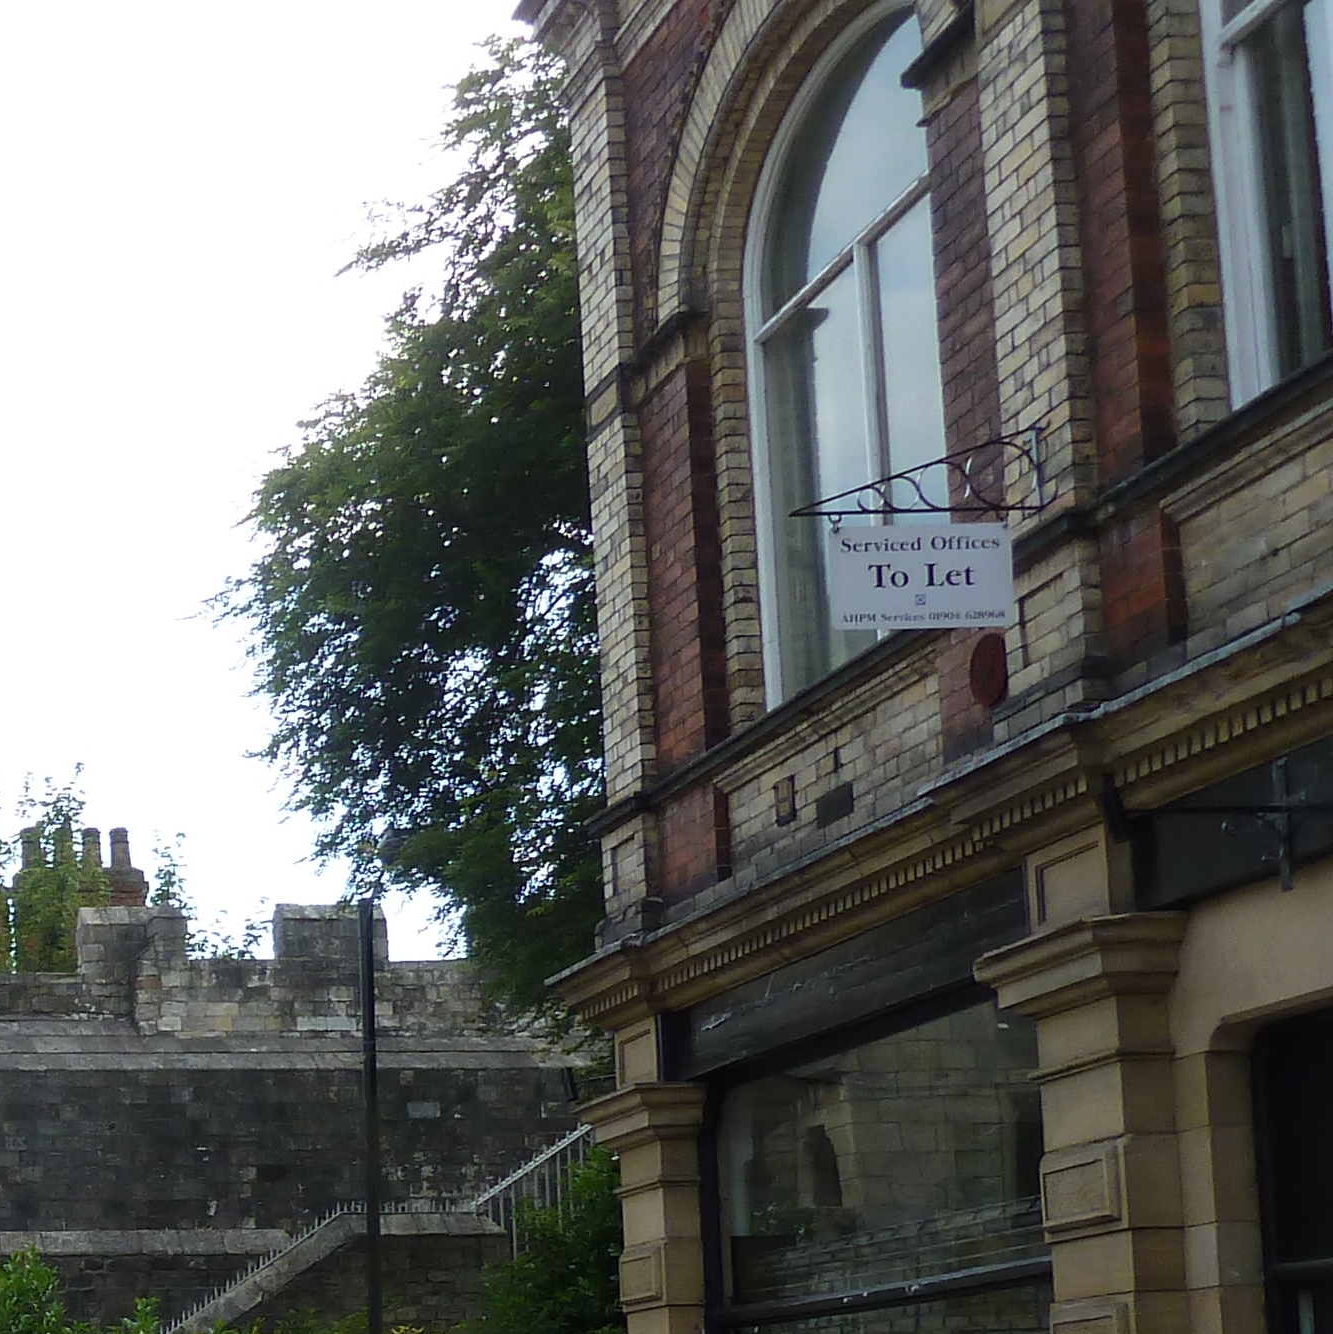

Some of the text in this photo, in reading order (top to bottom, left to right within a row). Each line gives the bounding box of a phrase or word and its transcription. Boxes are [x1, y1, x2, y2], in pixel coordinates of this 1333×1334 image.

[840, 535, 1000, 553] Serviced Offices
[867, 562, 976, 589] To Let
[880, 611, 925, 622] Services
[928, 610, 961, 621] 01904
